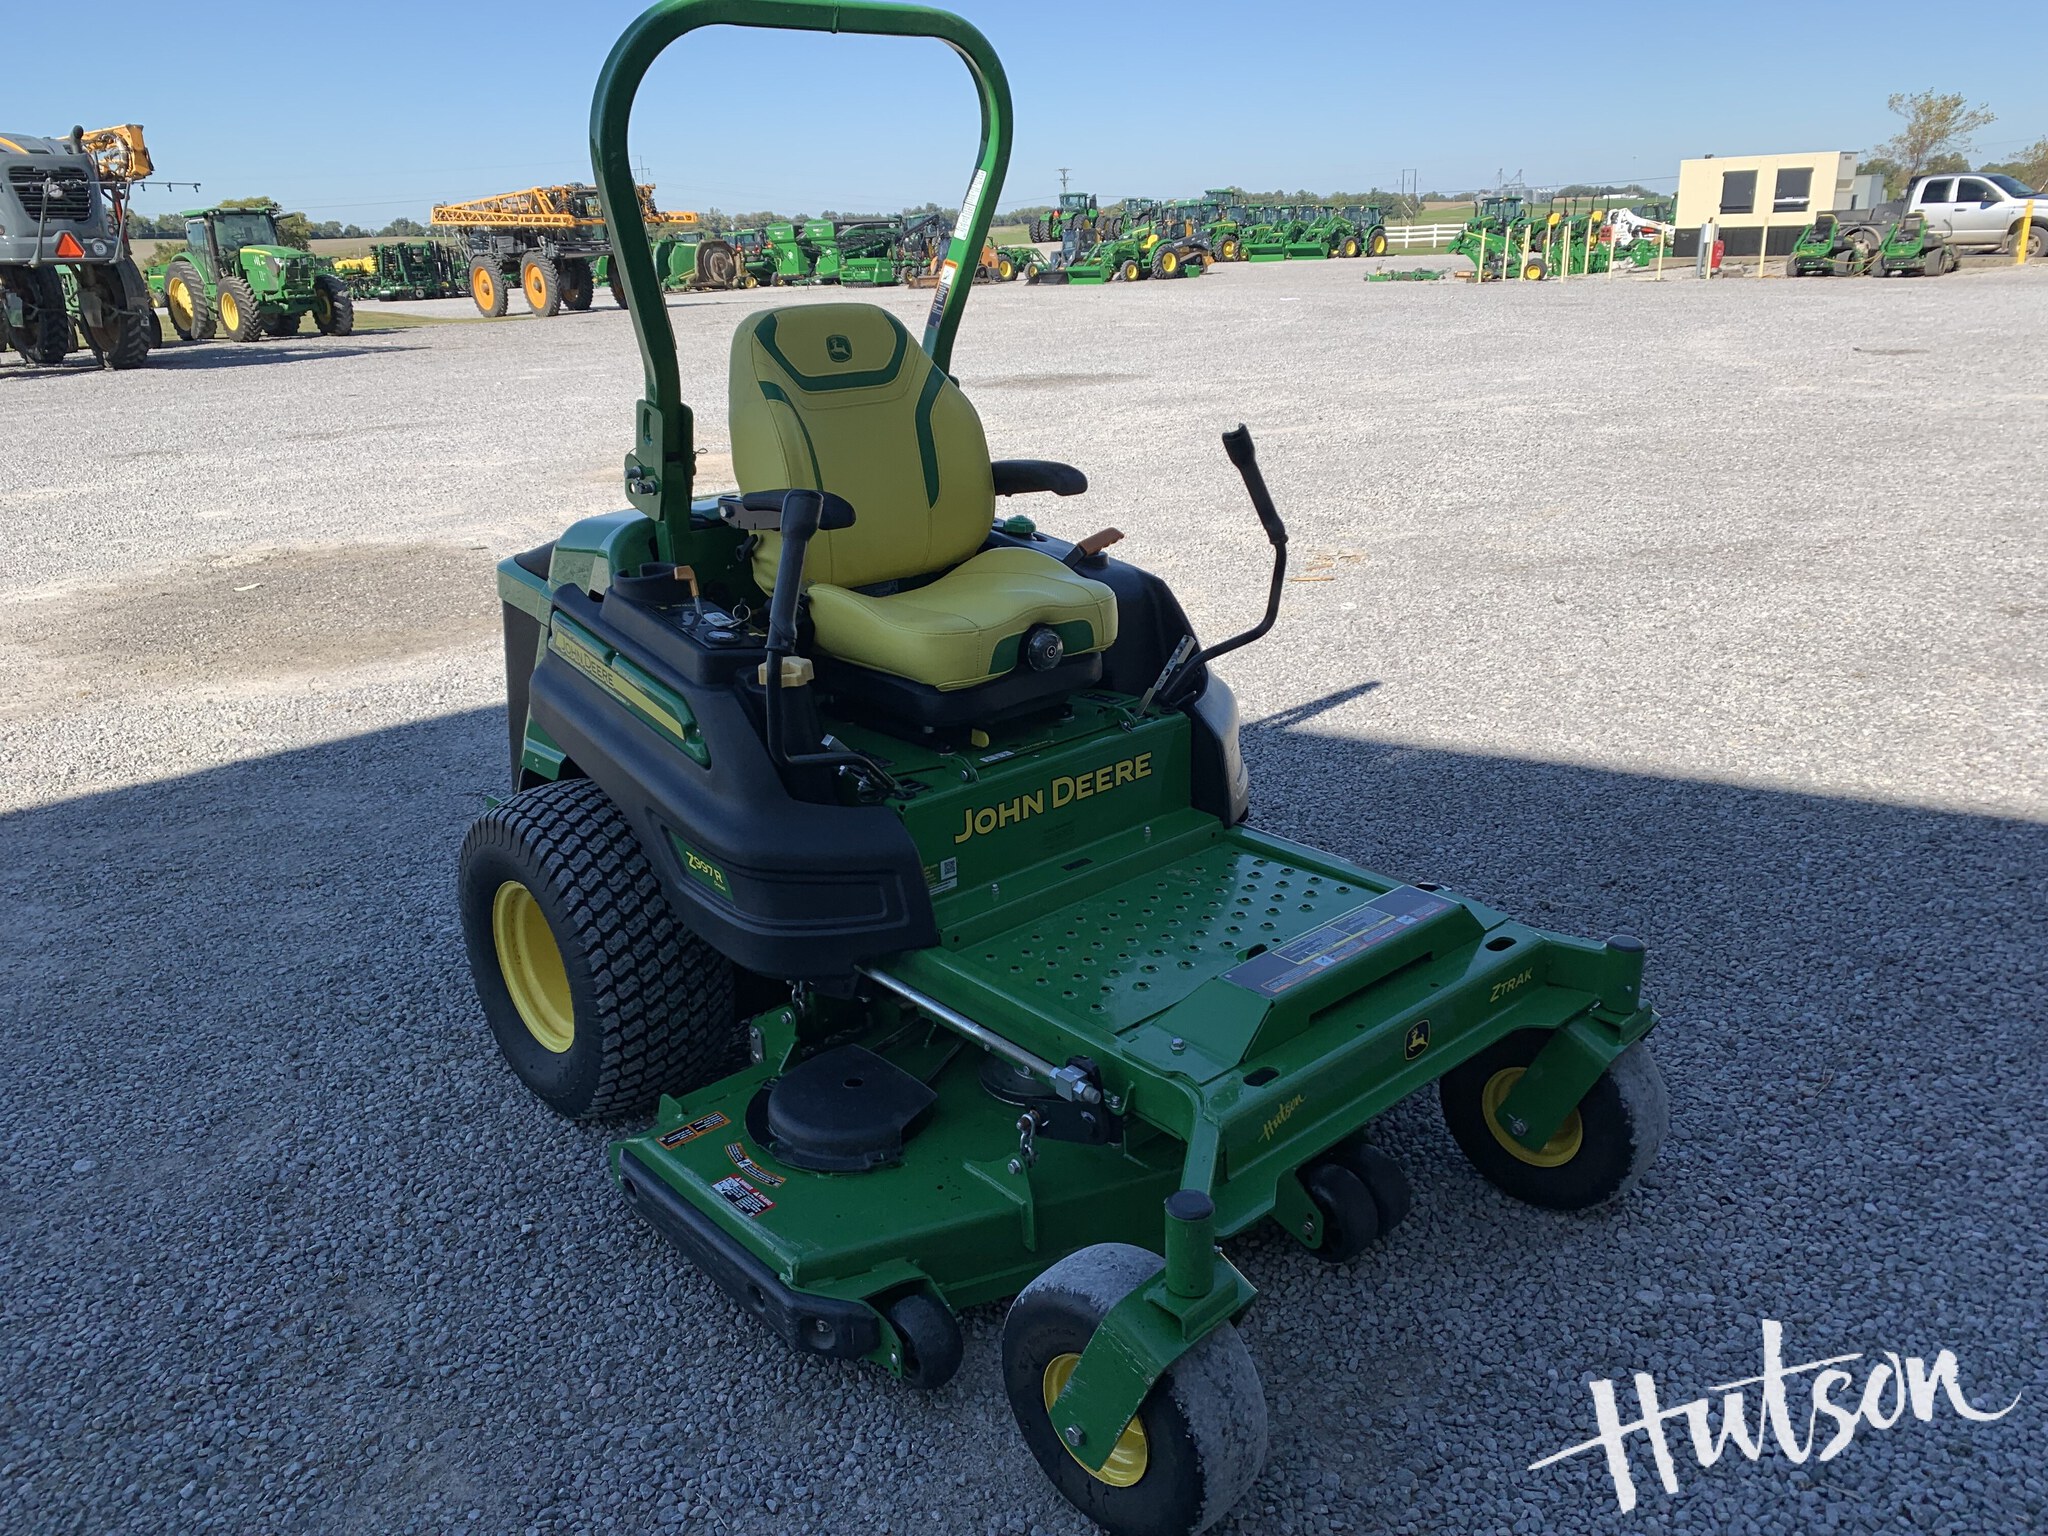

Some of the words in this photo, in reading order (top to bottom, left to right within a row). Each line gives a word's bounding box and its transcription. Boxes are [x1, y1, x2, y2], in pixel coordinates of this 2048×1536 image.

[560, 638, 584, 664] JOHN
[583, 651, 615, 688] DEERE
[954, 788, 1045, 845] JOHN
[1051, 751, 1153, 810] DEERE
[685, 850, 724, 884] Z997R
[1489, 966, 1533, 1003] ZTRAK
[1257, 1093, 1307, 1143] Hutson
